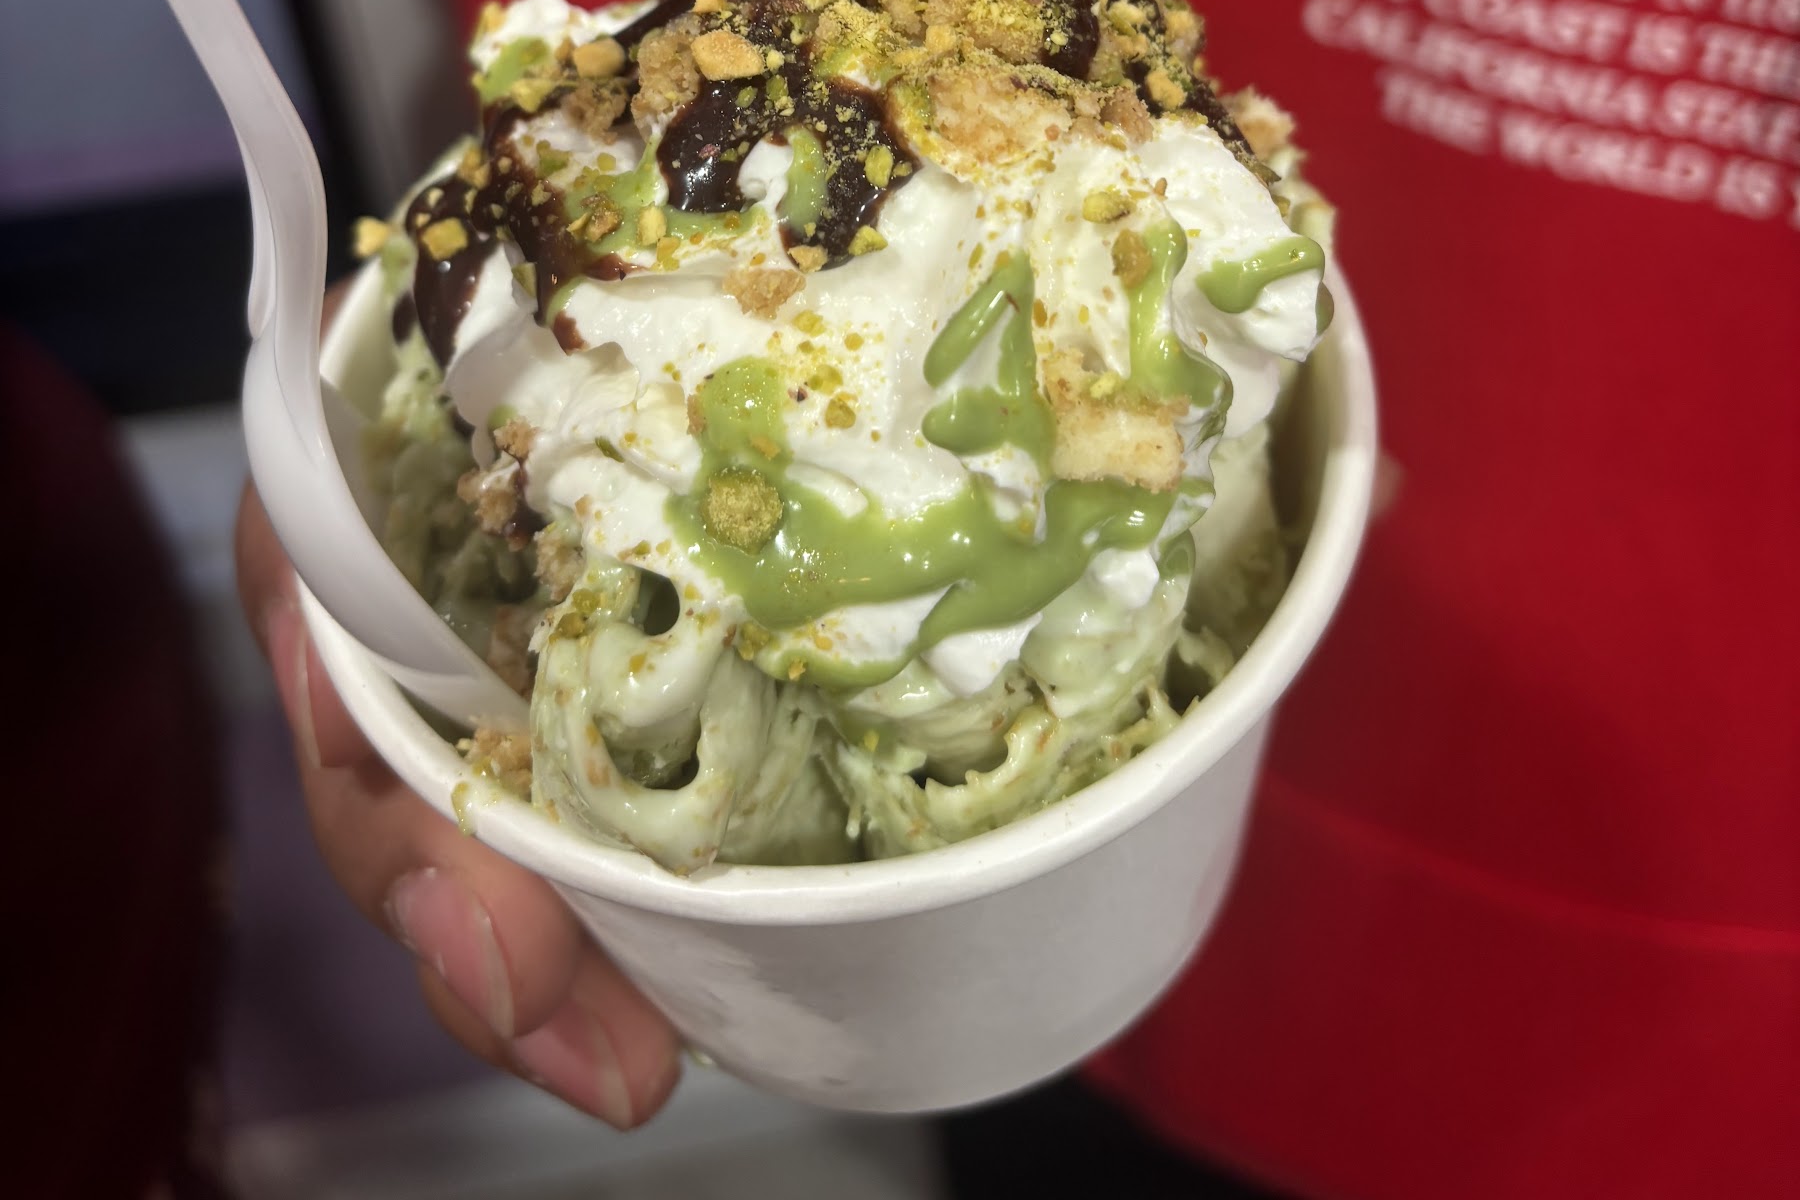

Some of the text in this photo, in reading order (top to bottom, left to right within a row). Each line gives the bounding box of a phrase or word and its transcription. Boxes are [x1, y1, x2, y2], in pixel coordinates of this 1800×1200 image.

[1628, 11, 1690, 75] IS
[1375, 66, 1492, 156] THE
[1500, 110, 1712, 202] WORLD
[1714, 158, 1780, 220] IS
